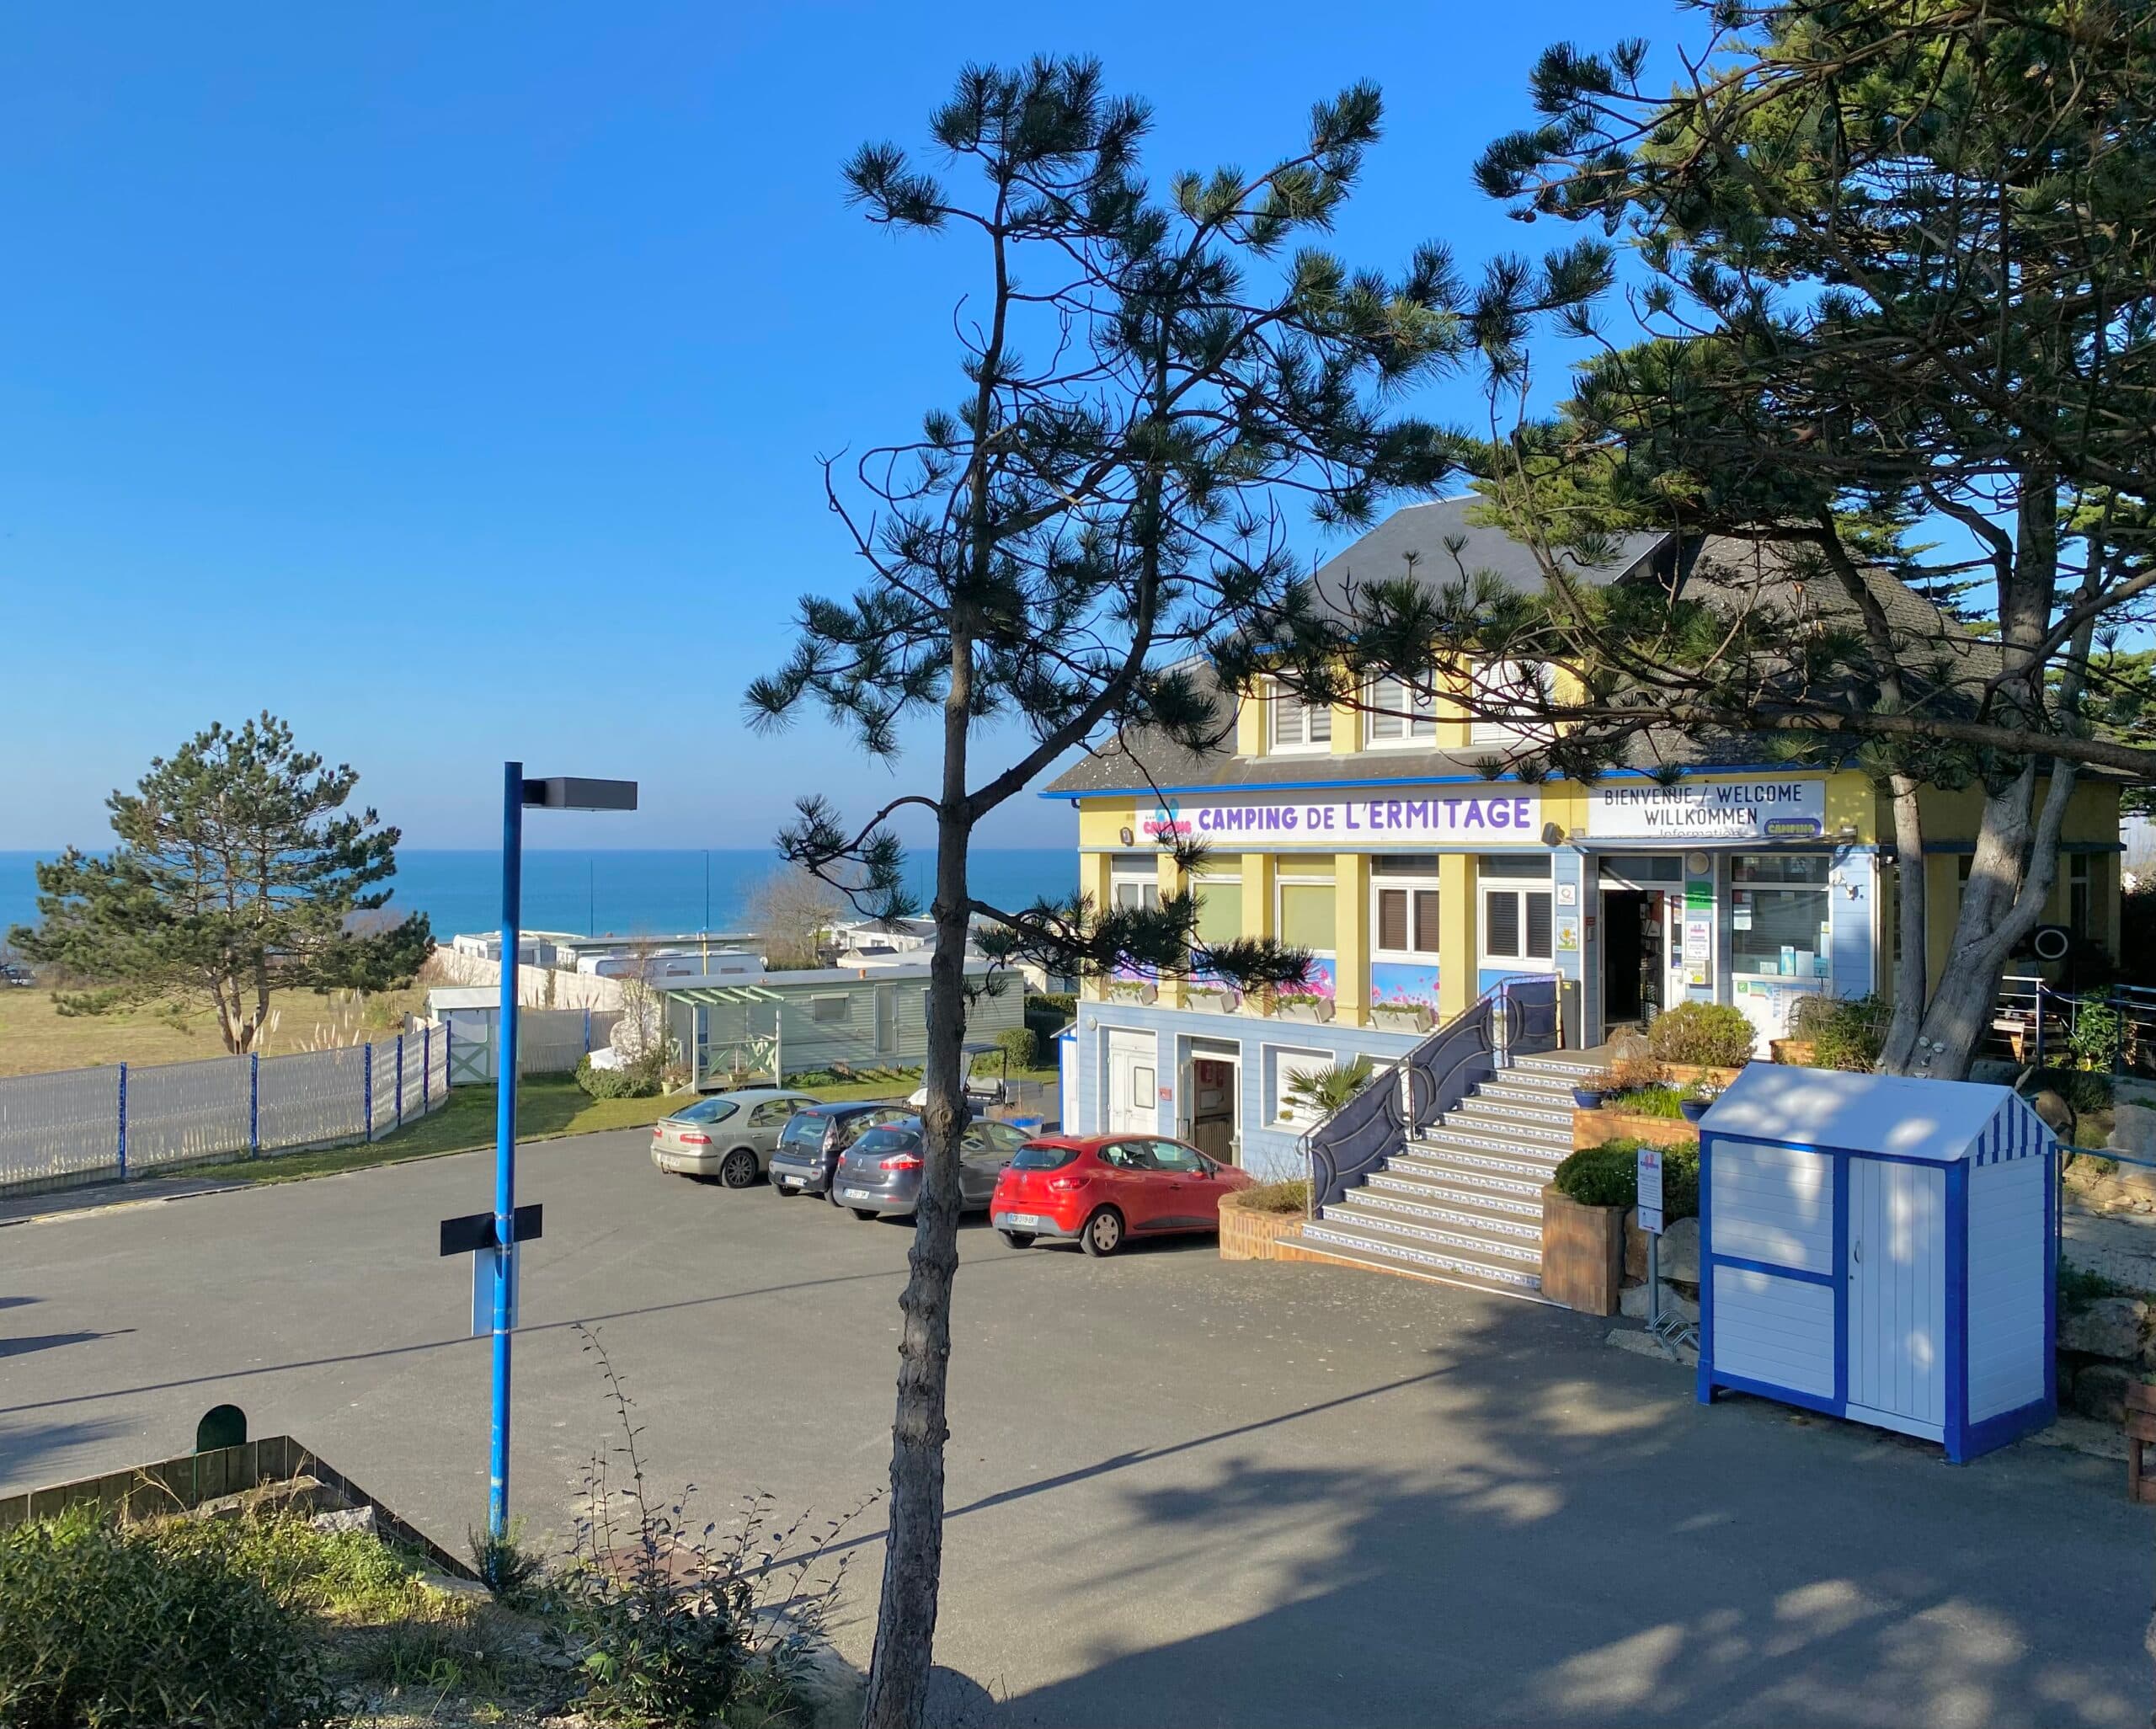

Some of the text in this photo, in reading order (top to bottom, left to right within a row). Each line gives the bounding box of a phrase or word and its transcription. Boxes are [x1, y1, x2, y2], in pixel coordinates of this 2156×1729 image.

[1604, 787, 1693, 805] BIENVENUE
[1716, 784, 1802, 803] WELCOME
[1198, 798, 1531, 830] CAMPING DE L'ERMITAGE
[1644, 808, 1758, 825] WILLKOMMEN
